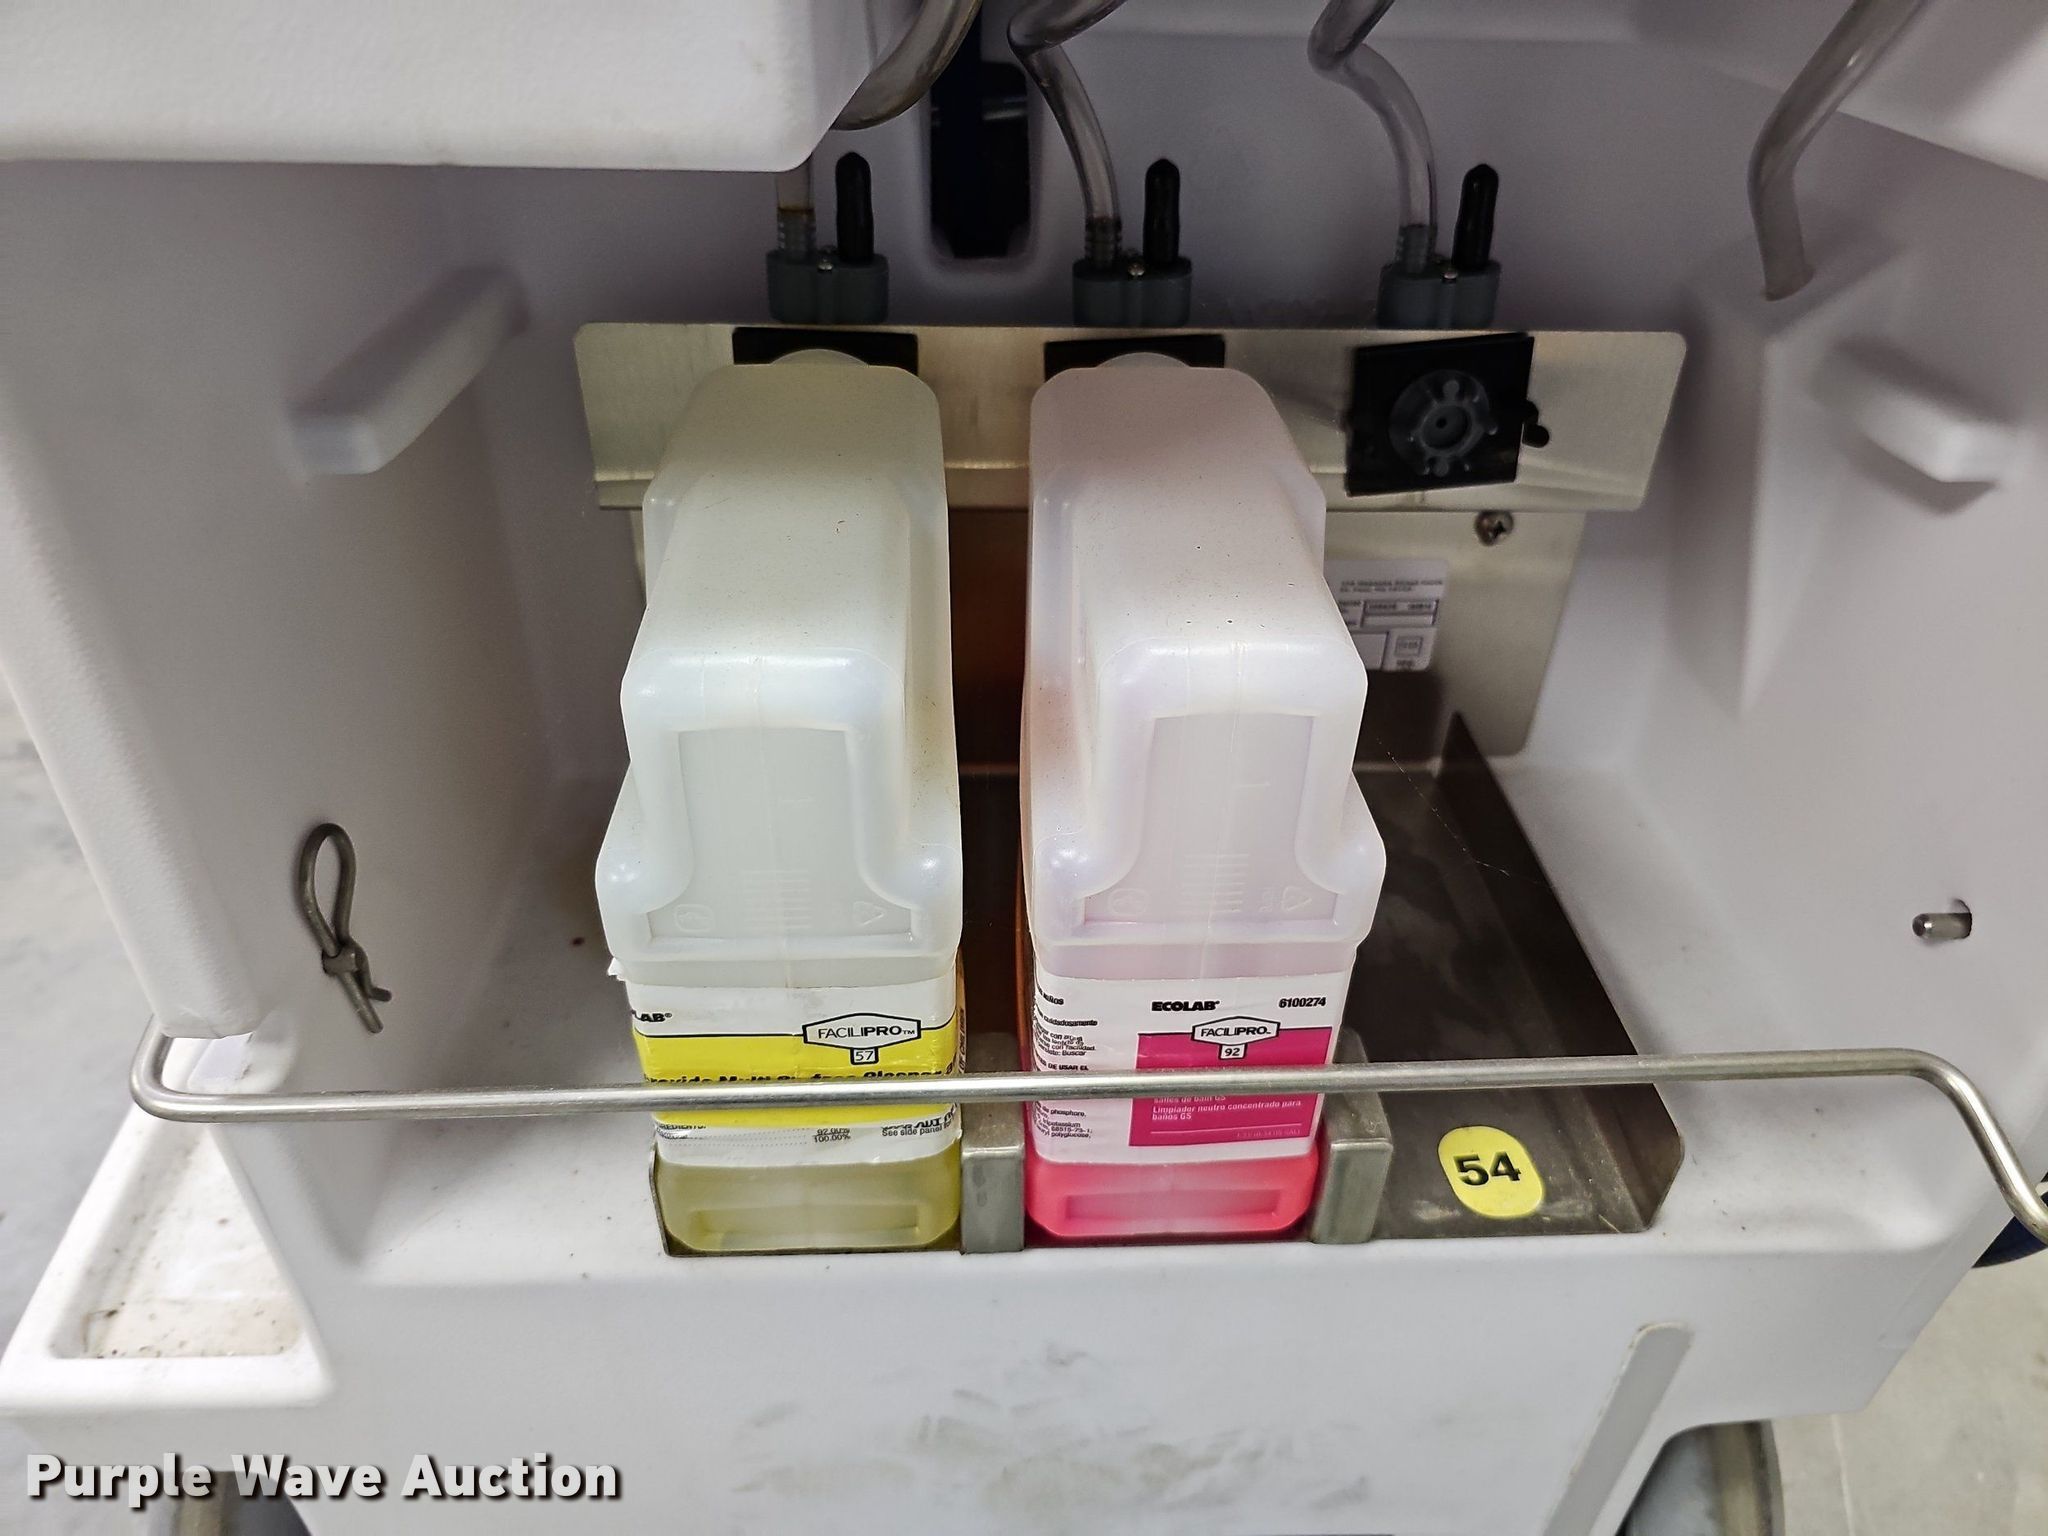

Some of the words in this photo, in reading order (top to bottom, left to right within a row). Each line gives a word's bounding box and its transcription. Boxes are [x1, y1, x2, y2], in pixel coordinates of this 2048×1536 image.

[1279, 997, 1326, 1008] 6100274
[855, 1051, 874, 1061] 57
[1225, 1048, 1240, 1057] 92
[1153, 1105, 1195, 1114] Limpiador
[1198, 1104, 1225, 1112] neutro
[1227, 1101, 1280, 1110] concentrado
[882, 1128, 898, 1137] See
[900, 1126, 917, 1136] side
[920, 1123, 942, 1135] panel
[1454, 1151, 1521, 1186] 54
